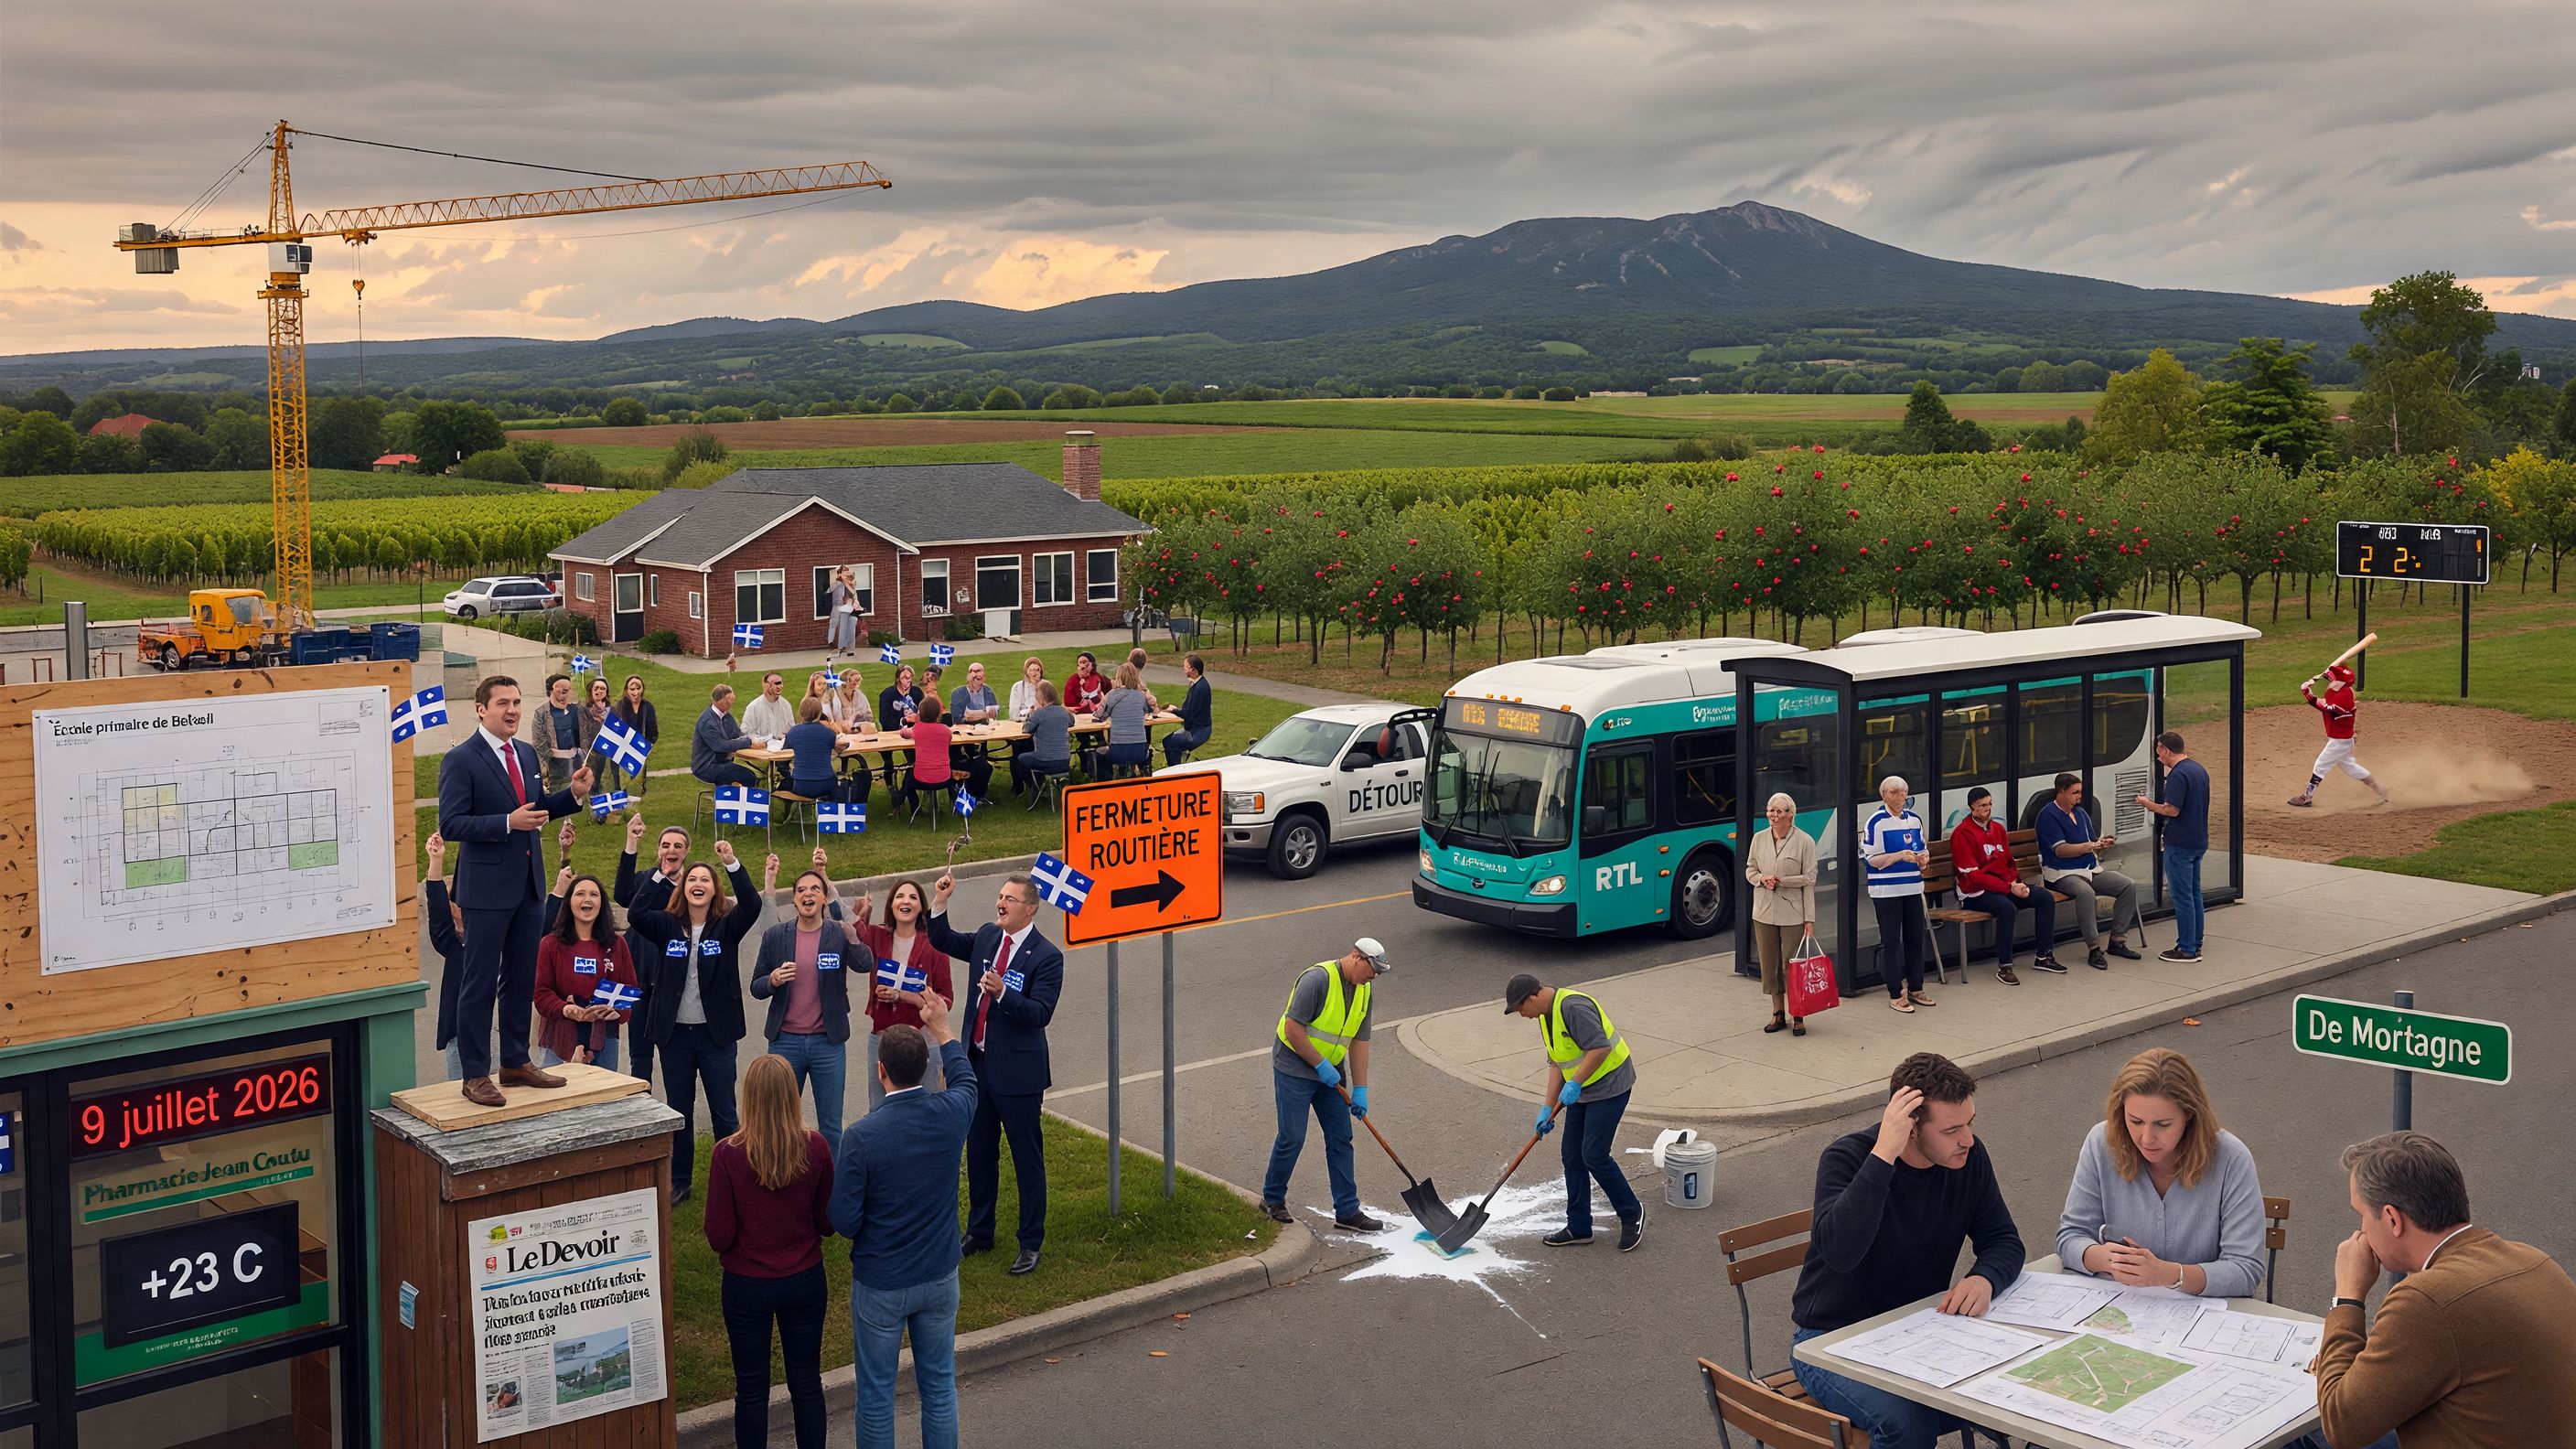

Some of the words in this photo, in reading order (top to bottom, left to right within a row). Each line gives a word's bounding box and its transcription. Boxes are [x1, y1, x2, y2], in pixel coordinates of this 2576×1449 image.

[2360, 545, 2373, 573] 2
[153, 716, 168, 728] de
[1077, 789, 1211, 833] FERMETURE
[1349, 779, 1423, 813] DÉTOUR
[1090, 826, 1199, 870] ROUTIÈRE
[1595, 862, 1643, 892] RTL
[2309, 1009, 2343, 1044] De
[2353, 1015, 2482, 1068] Mortagne
[81, 1105, 105, 1144] 9
[119, 1086, 220, 1149] juillet
[233, 1067, 319, 1117] 2026
[141, 1251, 220, 1300] +23
[232, 1242, 263, 1283] C
[506, 1246, 540, 1273] Le
[539, 1229, 620, 1268] Devoir
